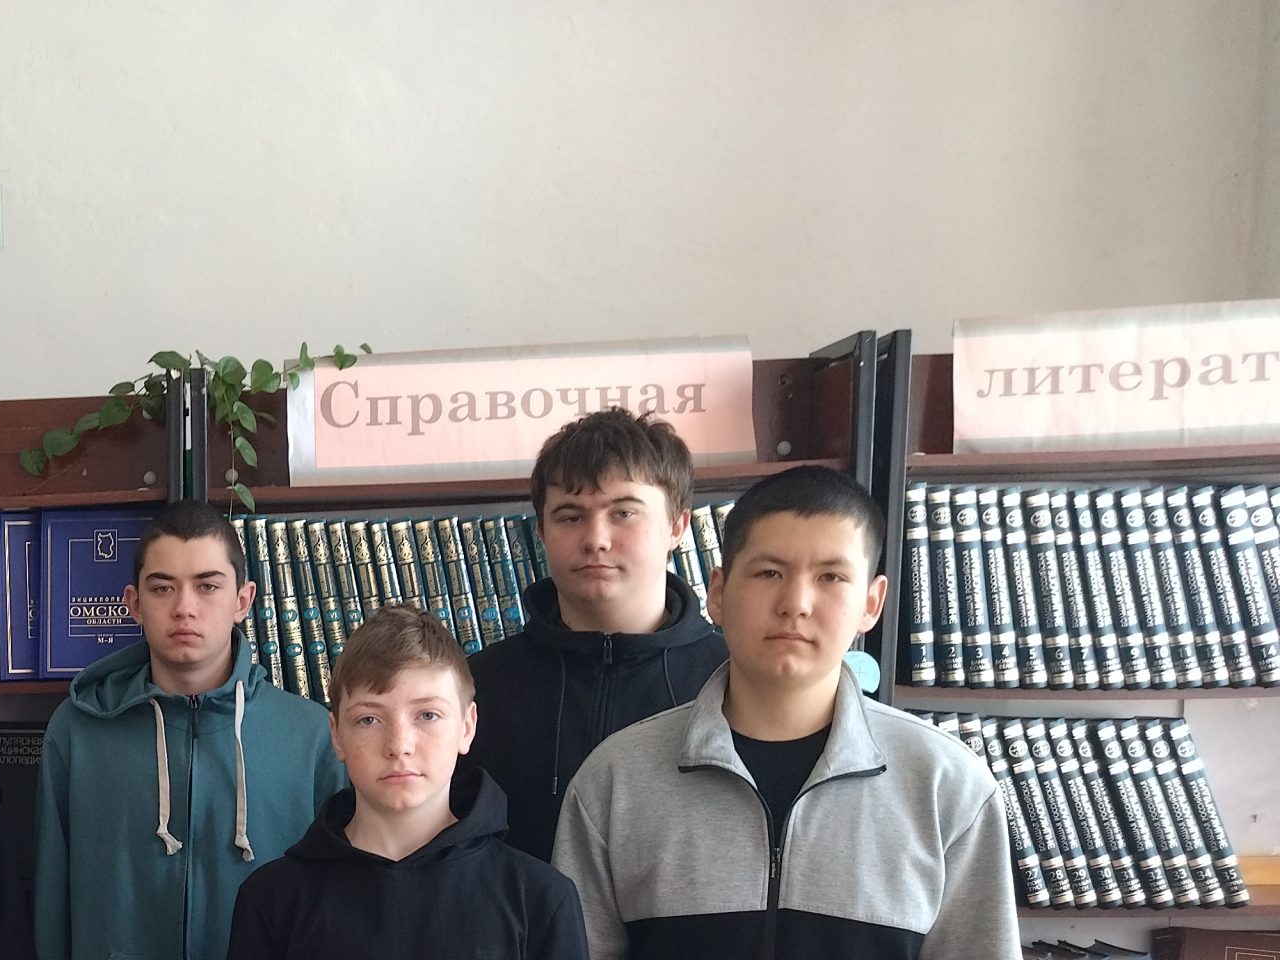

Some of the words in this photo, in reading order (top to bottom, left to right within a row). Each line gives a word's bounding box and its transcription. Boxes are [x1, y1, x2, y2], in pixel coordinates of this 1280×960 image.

[976, 351, 1280, 401] литерат
[319, 379, 707, 436] Справочная
[70, 605, 129, 617] ОМСКО
[920, 645, 926, 656] 1
[948, 646, 956, 657] 2
[975, 647, 983, 658] 3
[1002, 646, 1009, 657] 4
[1029, 648, 1036, 659] 5
[1055, 649, 1063, 660] 6
[1080, 648, 1089, 659] 7
[1106, 647, 1115, 659] 8
[1131, 648, 1139, 659] 9
[1154, 647, 1166, 658] 10
[1179, 647, 1192, 658] 11
[1206, 646, 1220, 657] 12
[1233, 645, 1247, 657] 13
[1261, 645, 1277, 657] 14
[1025, 867, 1038, 880] 27
[1049, 869, 1064, 881] 28
[1072, 868, 1086, 881] 29
[1098, 867, 1111, 880] 30
[1121, 868, 1134, 880] 31
[1148, 868, 1162, 881] 32
[1173, 867, 1187, 880] 33
[1197, 867, 1212, 880] 34
[1222, 867, 1237, 881] 35
